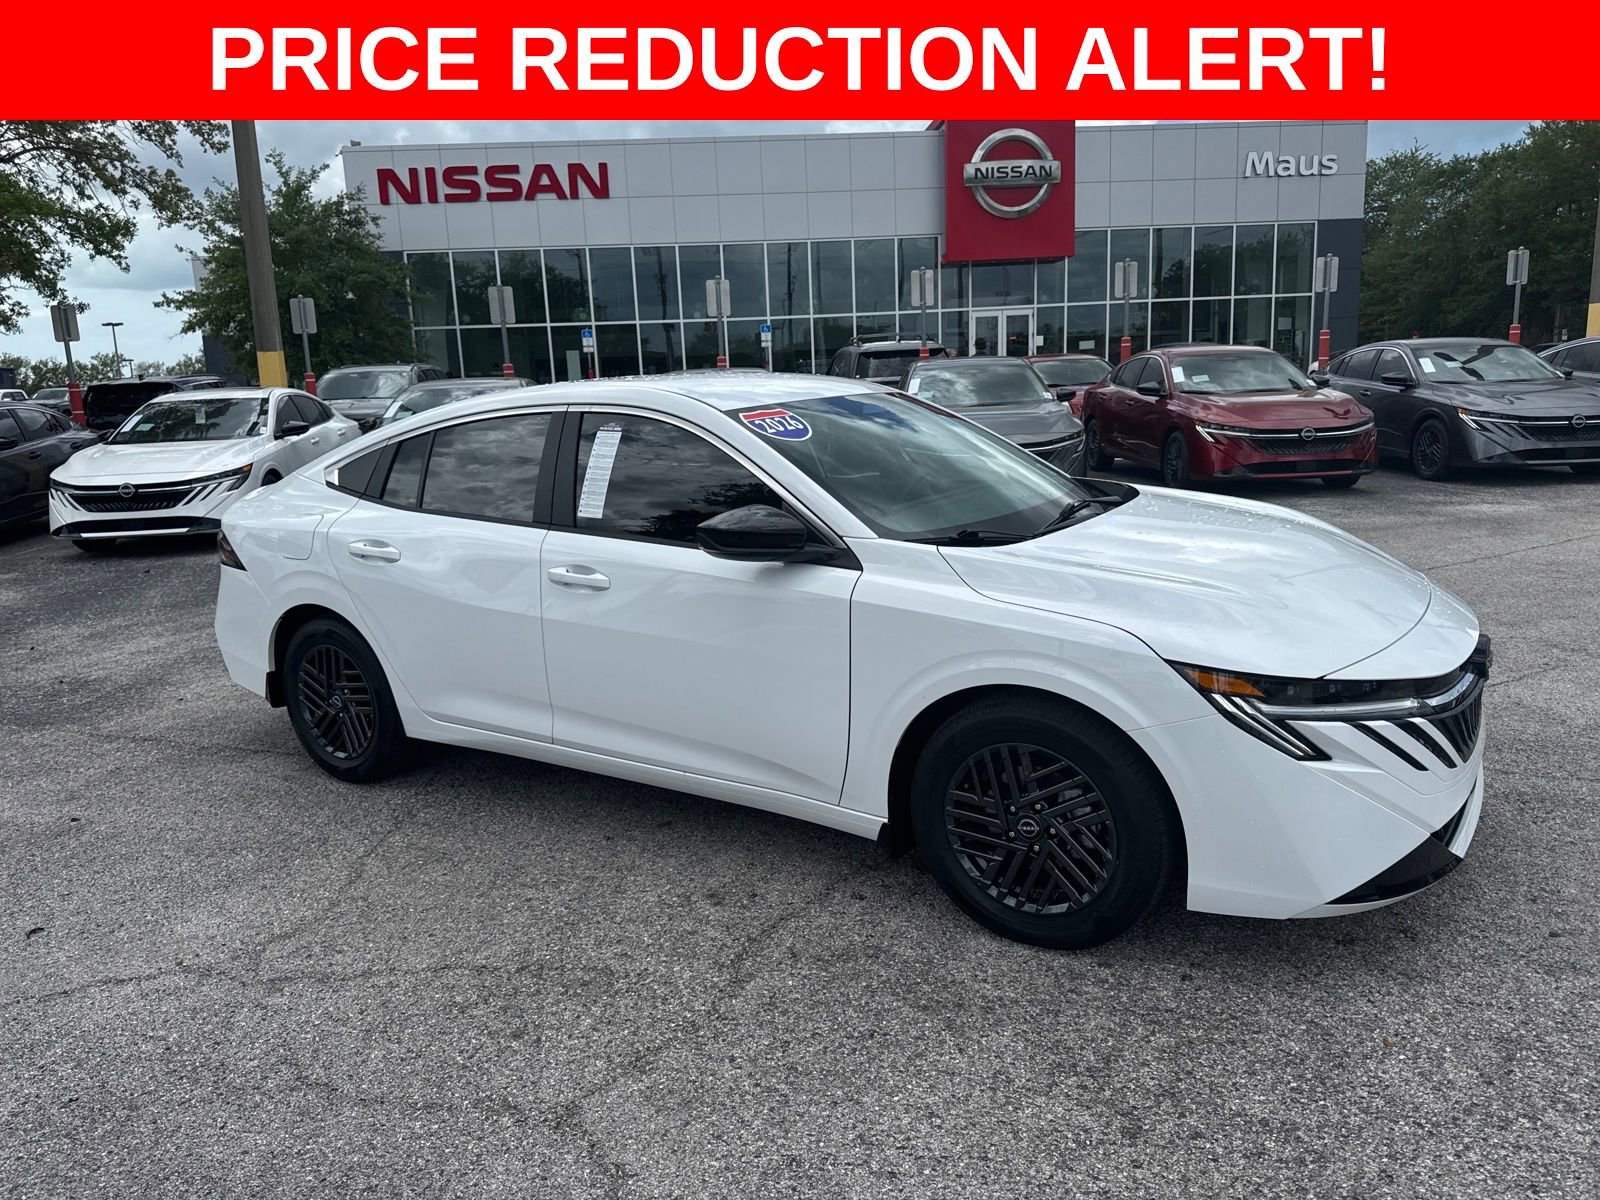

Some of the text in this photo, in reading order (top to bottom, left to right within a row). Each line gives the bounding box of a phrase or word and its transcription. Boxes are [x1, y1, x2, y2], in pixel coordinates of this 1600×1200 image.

[974, 165, 1052, 180] NISSAN
[1245, 151, 1338, 177] Maus
[376, 162, 610, 206] NISSAN
[754, 416, 804, 433] 2026
